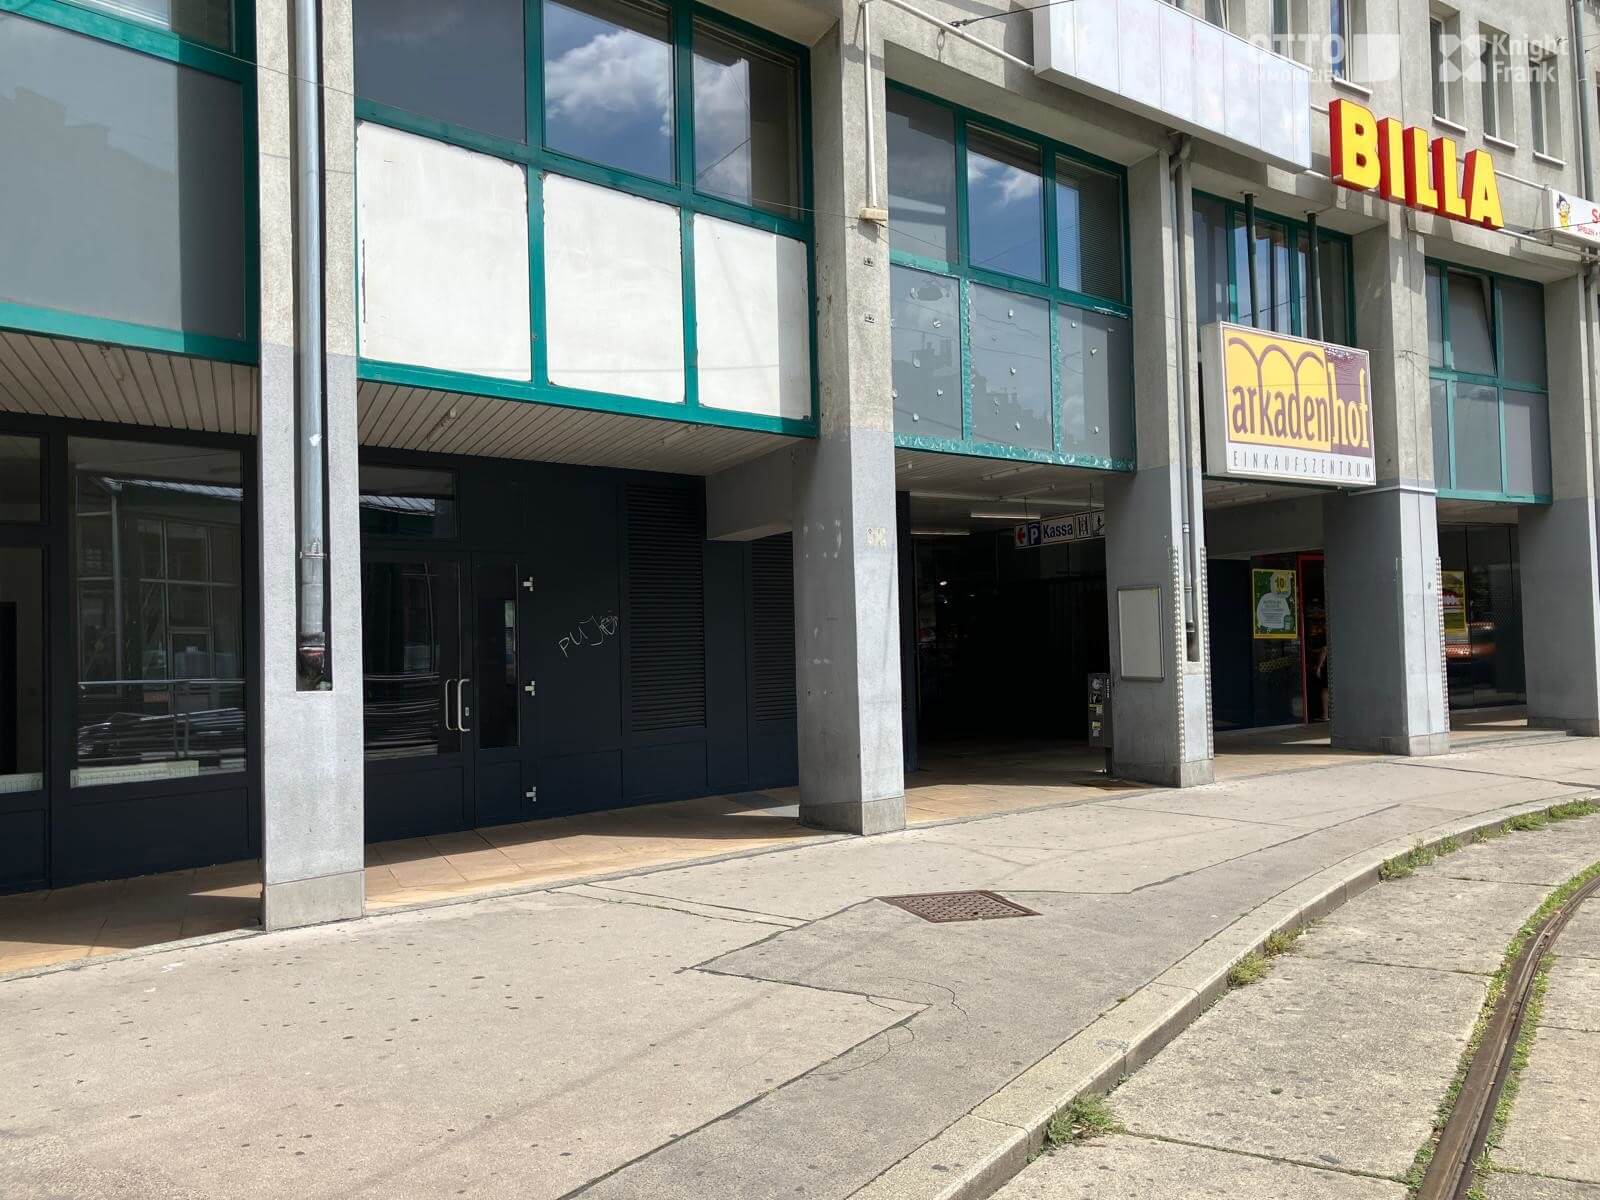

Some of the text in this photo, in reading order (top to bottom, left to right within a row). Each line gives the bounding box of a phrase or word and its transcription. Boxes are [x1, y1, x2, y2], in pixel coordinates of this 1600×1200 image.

[1329, 98, 1504, 230] BILLA
[1233, 450, 1371, 479] EINKAUFSZENTRUM
[1042, 522, 1074, 539] Kassa
